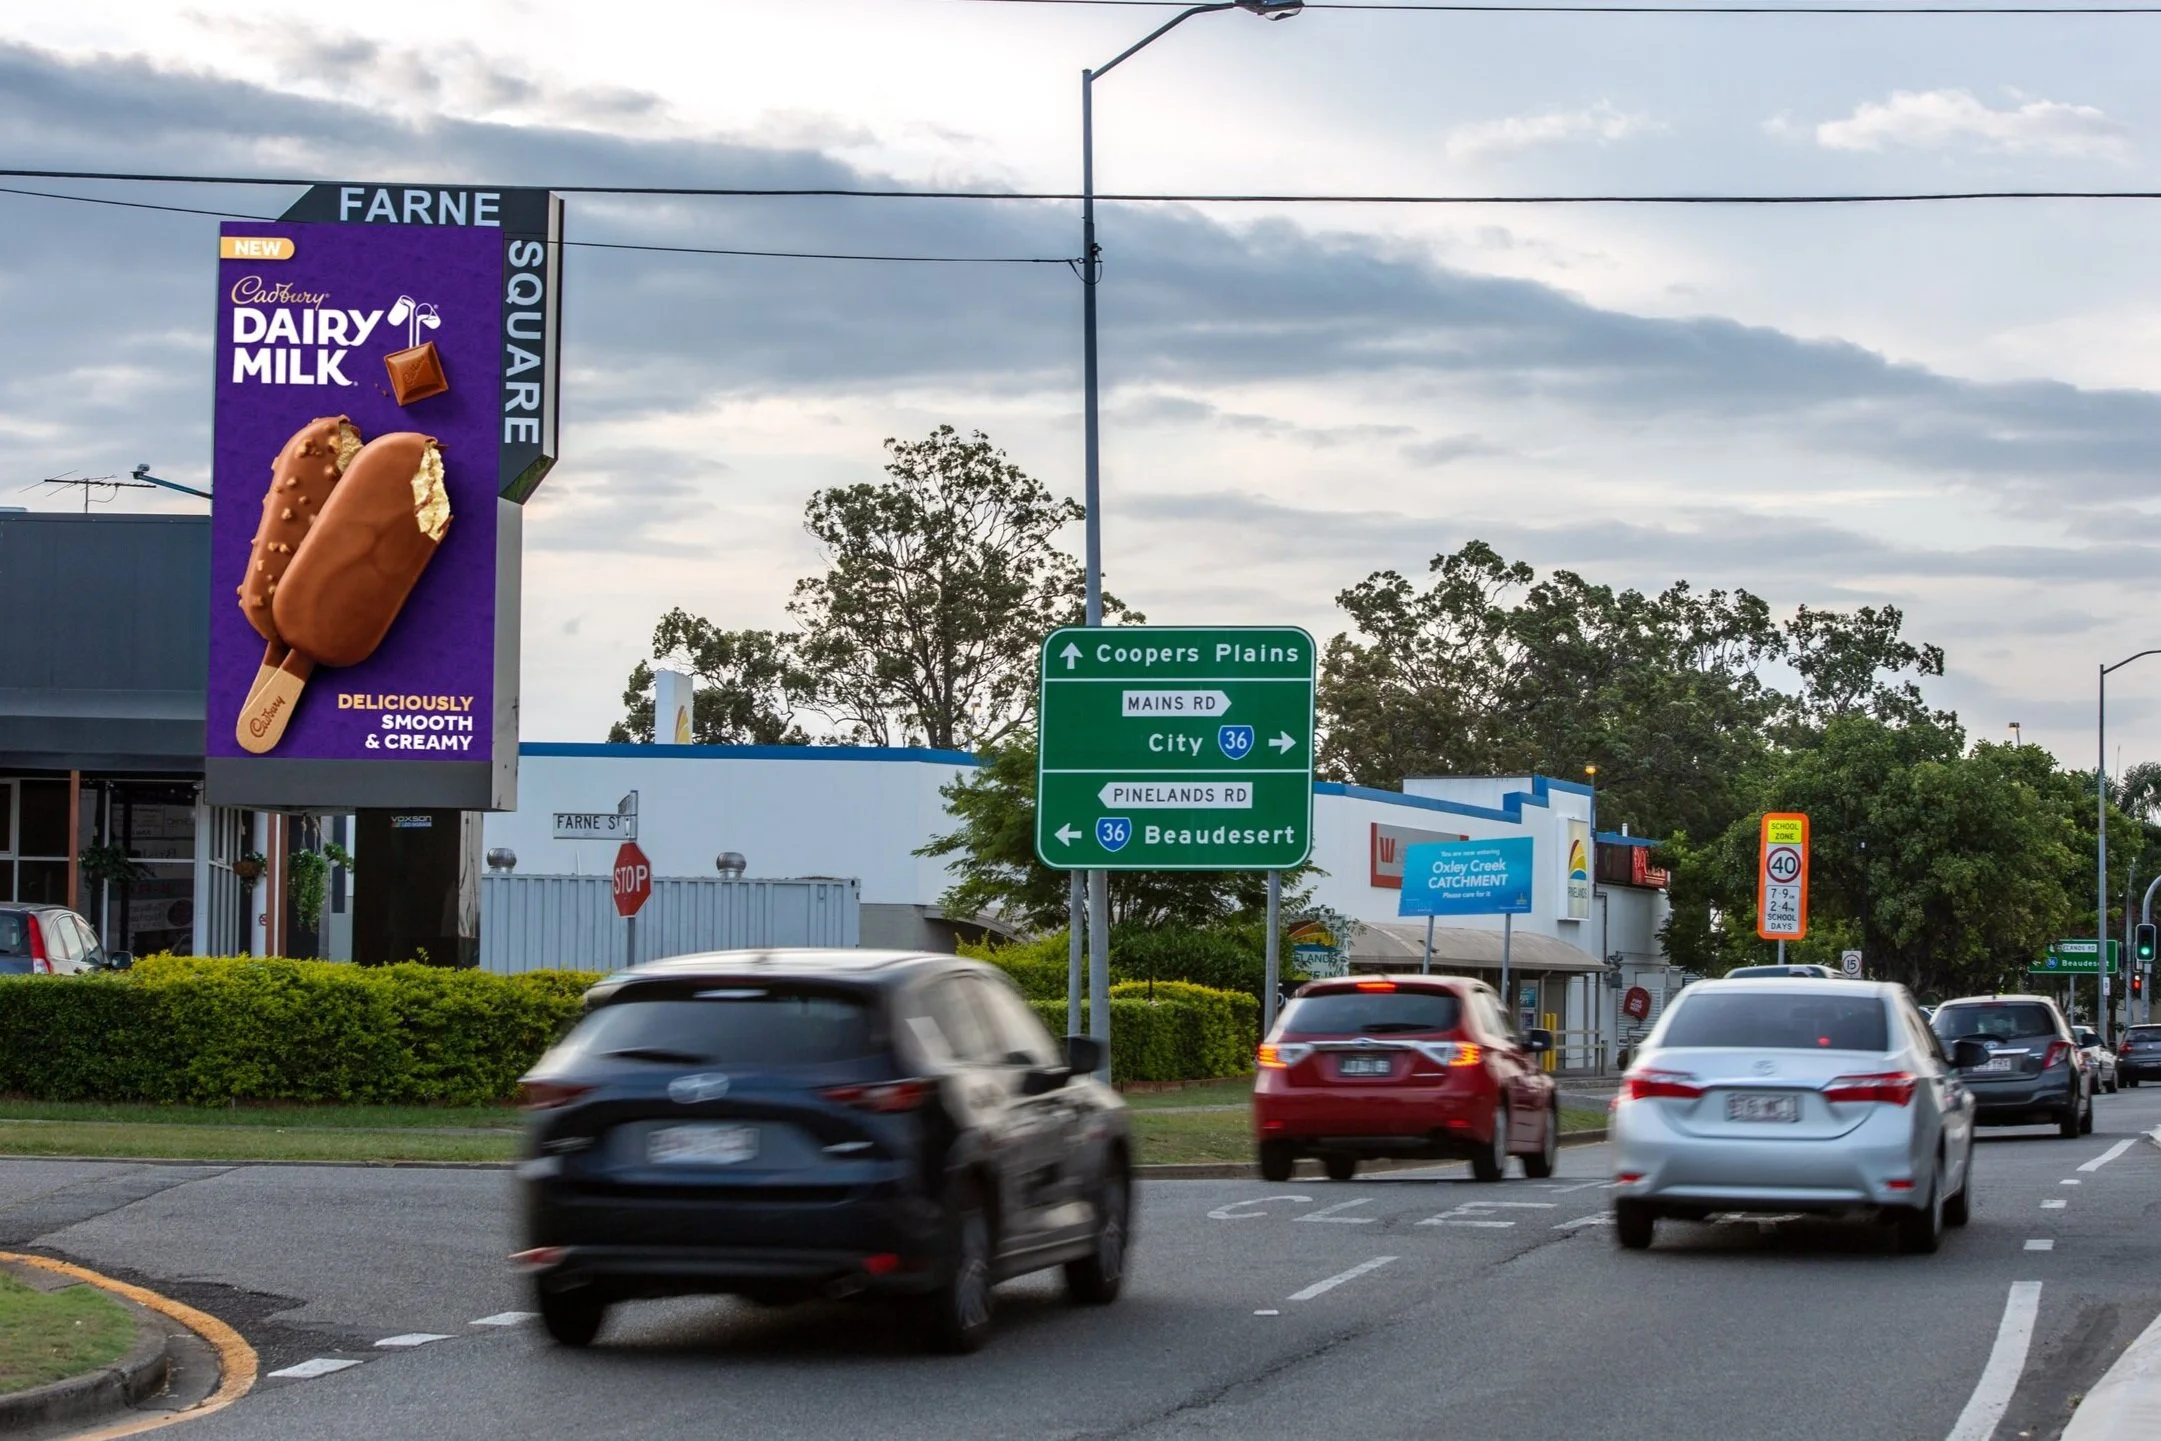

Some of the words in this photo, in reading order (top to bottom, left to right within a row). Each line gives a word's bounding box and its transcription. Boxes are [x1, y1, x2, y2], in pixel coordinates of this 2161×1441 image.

[339, 187, 500, 227] FARNE
[234, 240, 281, 257] NEW
[231, 275, 326, 311] Cadbury
[233, 307, 384, 347] DAIRY
[504, 239, 544, 445] SQUARE
[232, 347, 353, 387] MILK
[1096, 644, 1199, 667] Coopers
[1215, 643, 1299, 663] Plains
[338, 693, 474, 711] DELICIOUSLY
[1127, 696, 1184, 710] MAINS
[1193, 696, 1216, 710] RD
[250, 695, 286, 738] Cadbury
[381, 714, 473, 731] SMOOTH
[365, 733, 380, 749] &
[384, 734, 473, 751] CREAMY
[1149, 733, 1203, 756] City
[1224, 730, 1248, 750] 36
[1113, 788, 1215, 803] PINELANDS
[1224, 788, 1247, 802] RD
[557, 815, 601, 830] FARNE
[1771, 822, 1799, 831] SCHOOL
[1102, 823, 1125, 842] 36
[1144, 825, 1295, 845] Beaudesert
[1775, 832, 1795, 840] ZONE
[1432, 860, 1468, 876] Oxley
[1470, 857, 1507, 872] Creek
[1771, 856, 1797, 875] 40
[614, 864, 649, 895] STOP
[1428, 873, 1509, 889] CATCHMENT
[1767, 913, 1797, 922] SCHOOL
[1770, 922, 1793, 931] DAYS
[1846, 960, 1857, 970] 15
[2061, 959, 2110, 967] Beaudest
